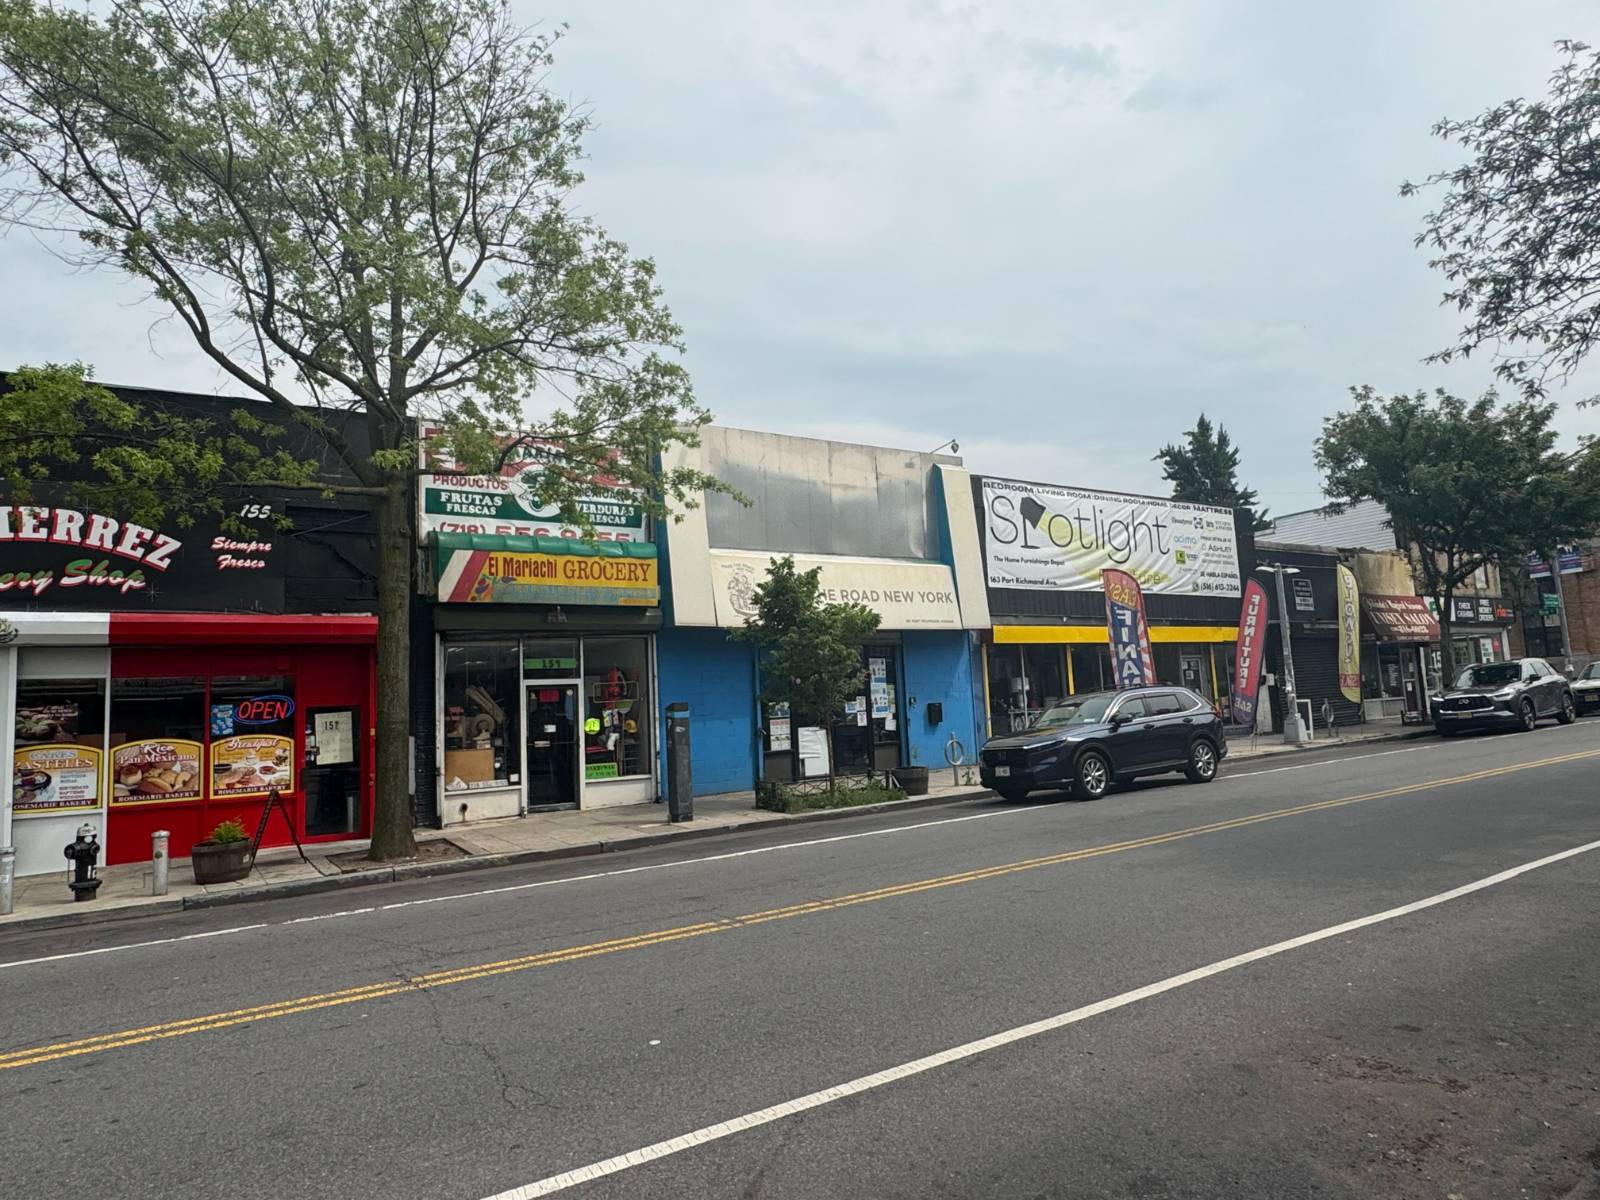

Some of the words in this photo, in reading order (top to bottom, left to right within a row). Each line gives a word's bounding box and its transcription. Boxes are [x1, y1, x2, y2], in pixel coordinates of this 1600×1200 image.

[433, 473, 508, 490] PRODUCTOS
[440, 491, 502, 507] FRUTAS
[983, 481, 1034, 494] BEDROOM
[1066, 490, 1091, 500] ROOM
[1193, 504, 1233, 516] MATTRESS
[240, 504, 271, 518] 155
[446, 503, 497, 516] FRESCAS
[211, 536, 272, 553] Siempre
[217, 554, 266, 571] Fresco
[488, 557, 498, 577] El
[503, 557, 557, 579] Mariachi
[563, 559, 652, 582] GROCERY
[60, 558, 146, 595] Shop
[1016, 577, 1045, 585] Richmond
[840, 589, 880, 602] ROAD
[883, 590, 914, 603] NEW
[918, 591, 953, 604] YORK
[237, 701, 288, 720] OPEN
[30, 750, 77, 760] CAKES
[60, 799, 92, 807] BAKERY
[118, 793, 162, 802] ROSEMARIE
